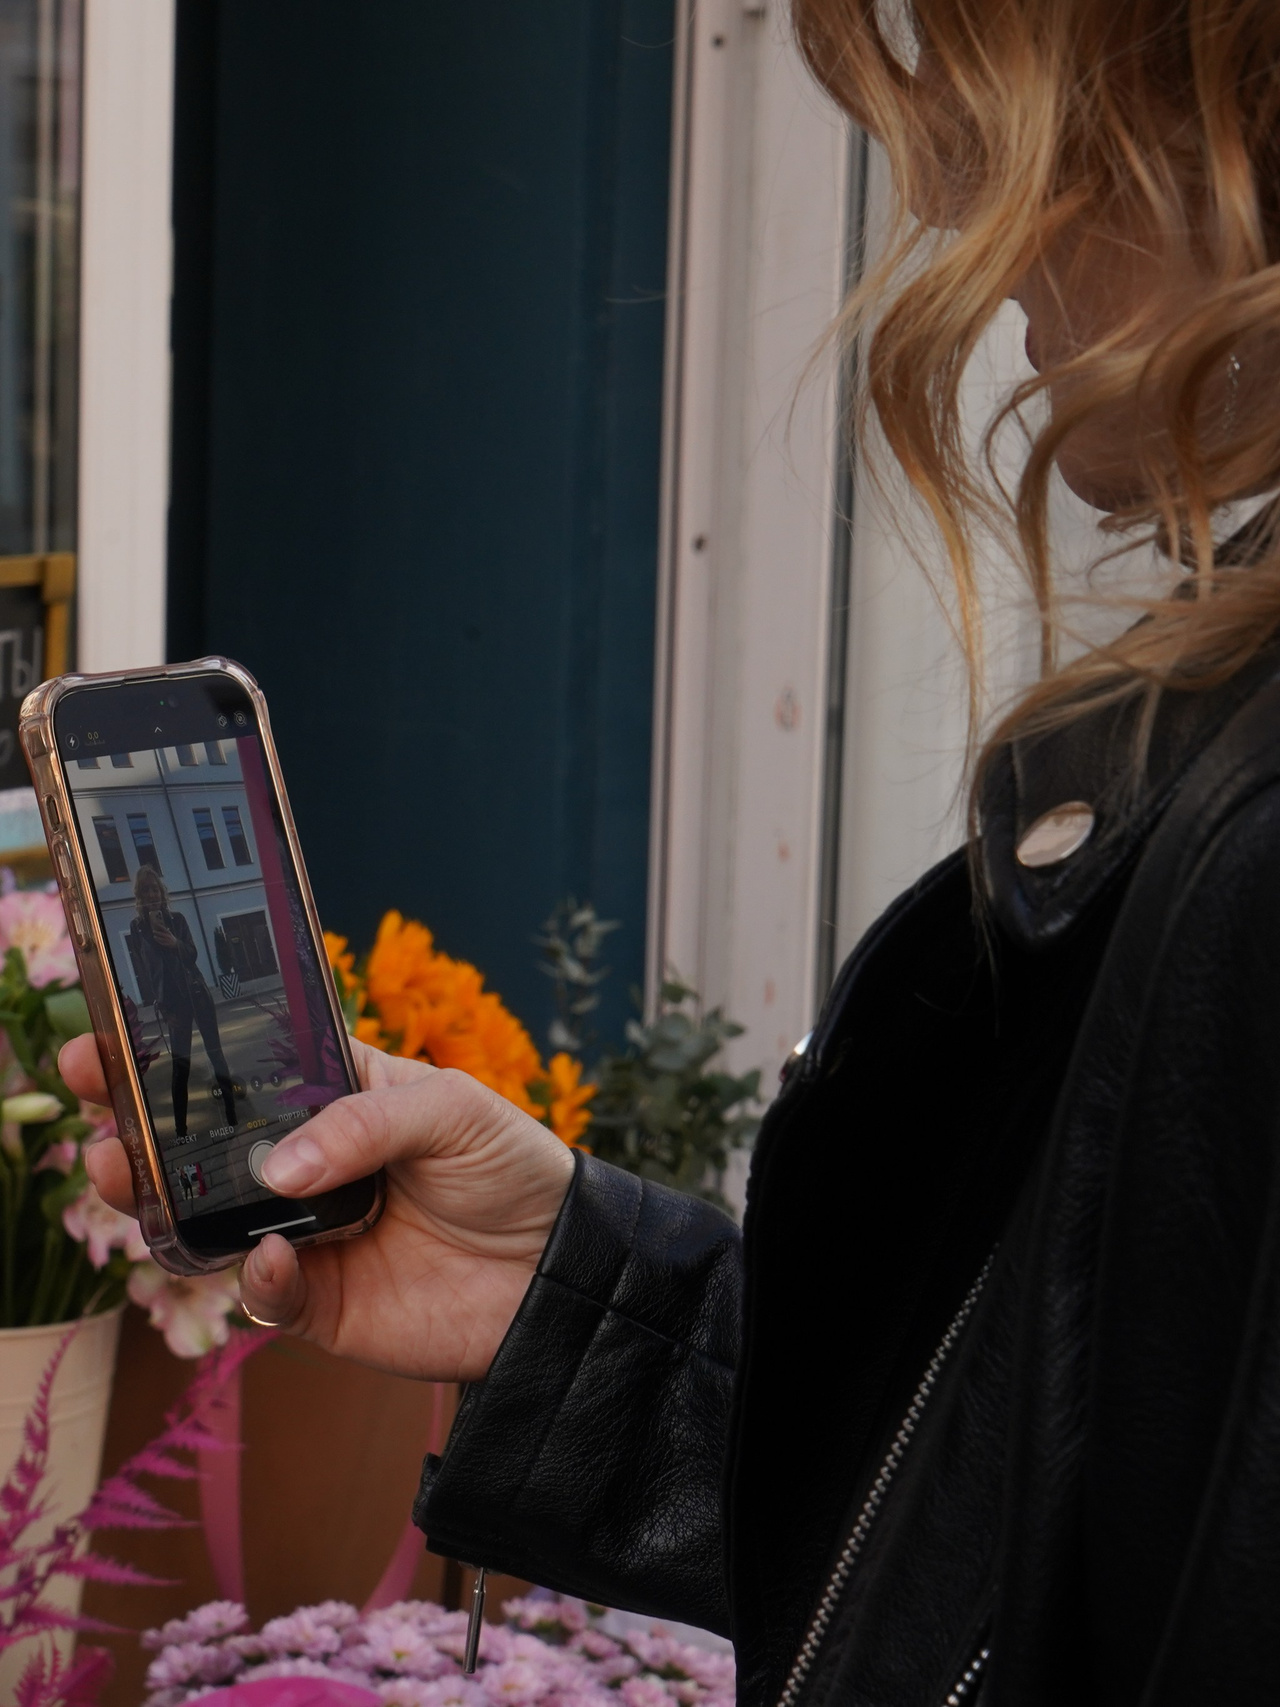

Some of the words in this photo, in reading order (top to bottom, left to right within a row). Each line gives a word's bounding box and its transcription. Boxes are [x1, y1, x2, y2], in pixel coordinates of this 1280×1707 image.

[213, 1088, 223, 1096] 0,5
[209, 1125, 235, 1138] ВИДЕО
[246, 1118, 267, 1129] ФОТО
[278, 1108, 309, 1123] ПОРТРЕТ
